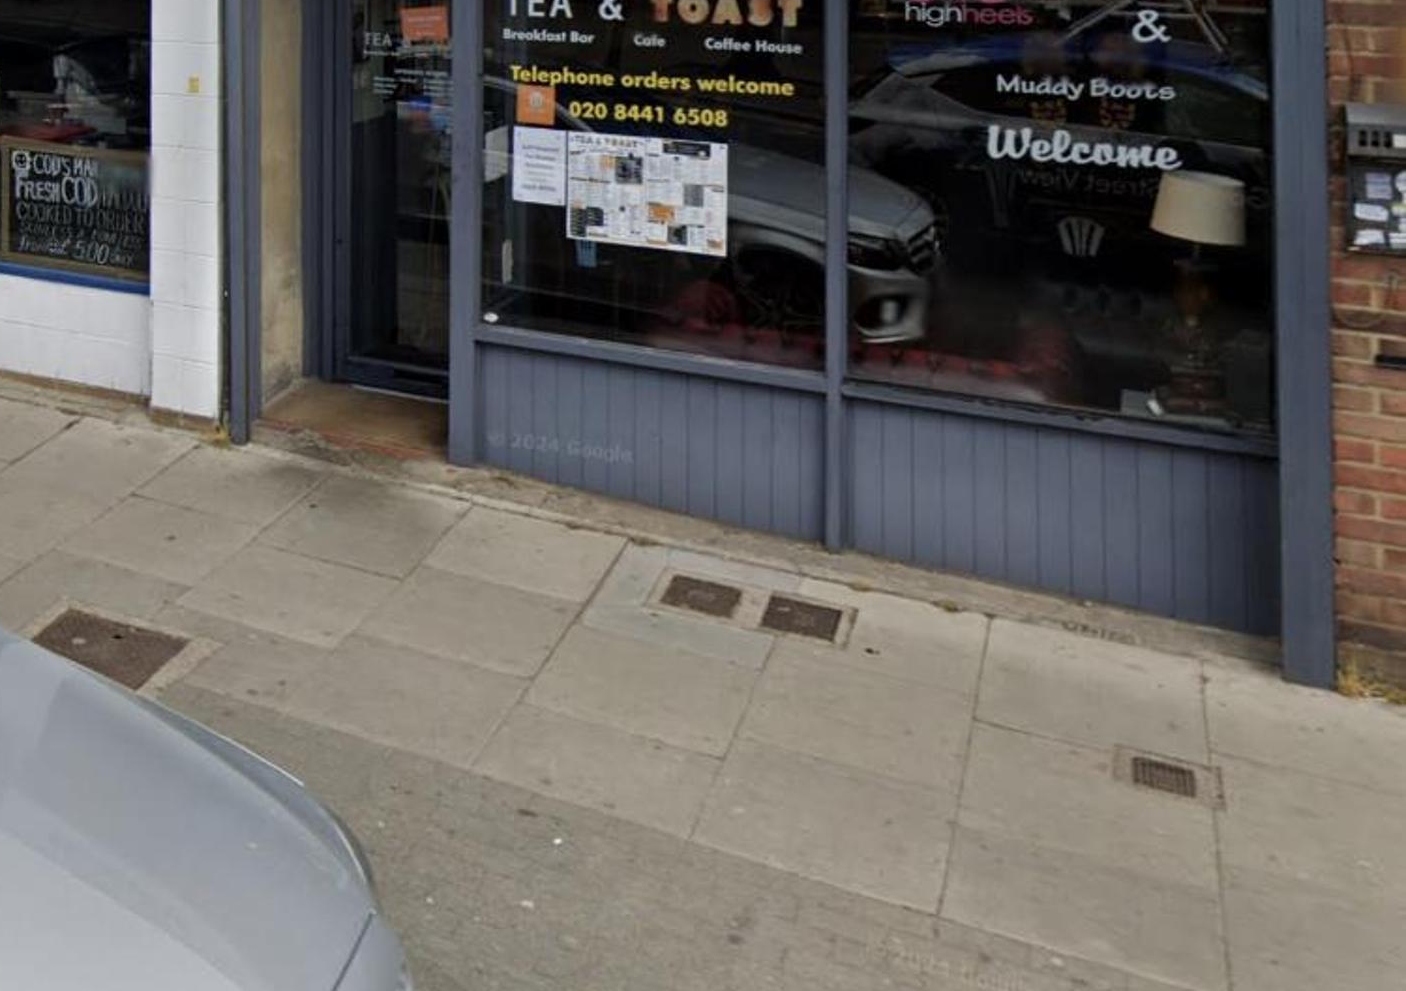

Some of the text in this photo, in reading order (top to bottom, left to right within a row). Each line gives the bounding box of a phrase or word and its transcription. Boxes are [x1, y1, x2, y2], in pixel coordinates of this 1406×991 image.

[503, 28, 595, 44] Breakfast Bar
[1132, 10, 1171, 43] &
[633, 34, 666, 47] Cafe
[705, 37, 803, 55] Coffee House
[510, 65, 795, 96] Telephone orders welcome
[996, 74, 1177, 101] Muddy Boots
[569, 101, 729, 128] 020 8441 6508
[986, 125, 1184, 171] Welcome
[61, 176, 98, 207] COD
